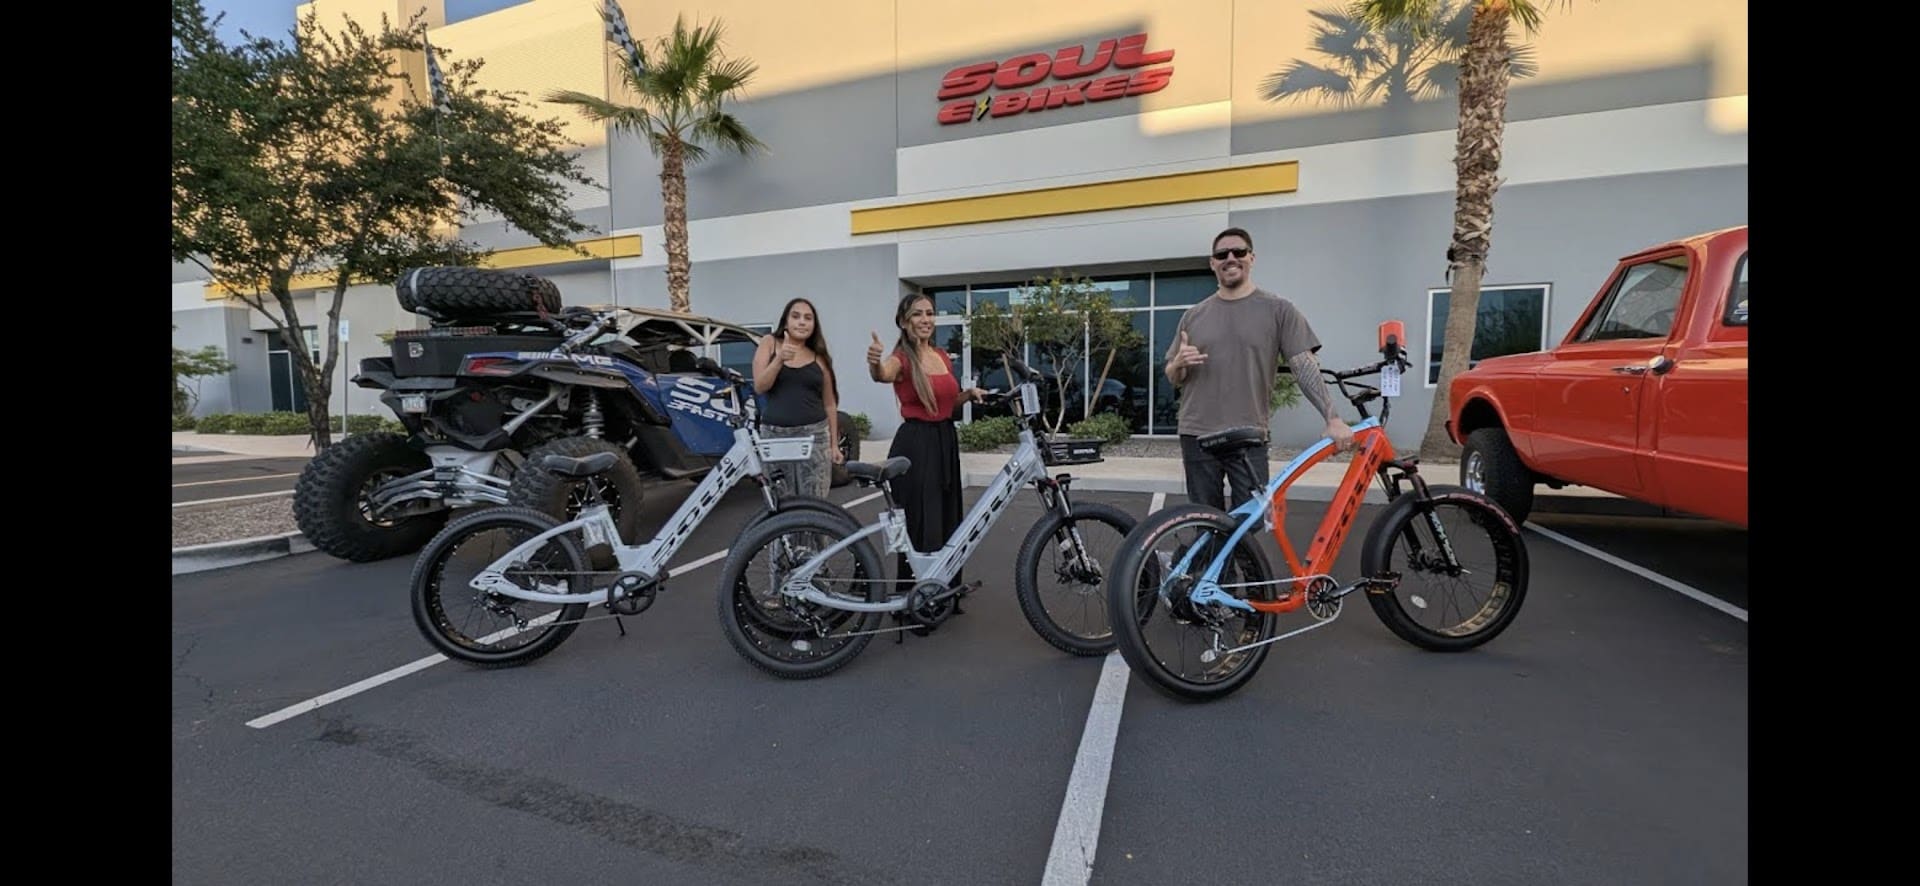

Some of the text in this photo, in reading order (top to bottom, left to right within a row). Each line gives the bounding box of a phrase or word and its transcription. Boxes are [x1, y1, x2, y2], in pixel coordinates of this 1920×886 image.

[937, 33, 1175, 100] SOUL
[651, 454, 749, 568] SOUL
[944, 460, 1037, 577] SOUL
